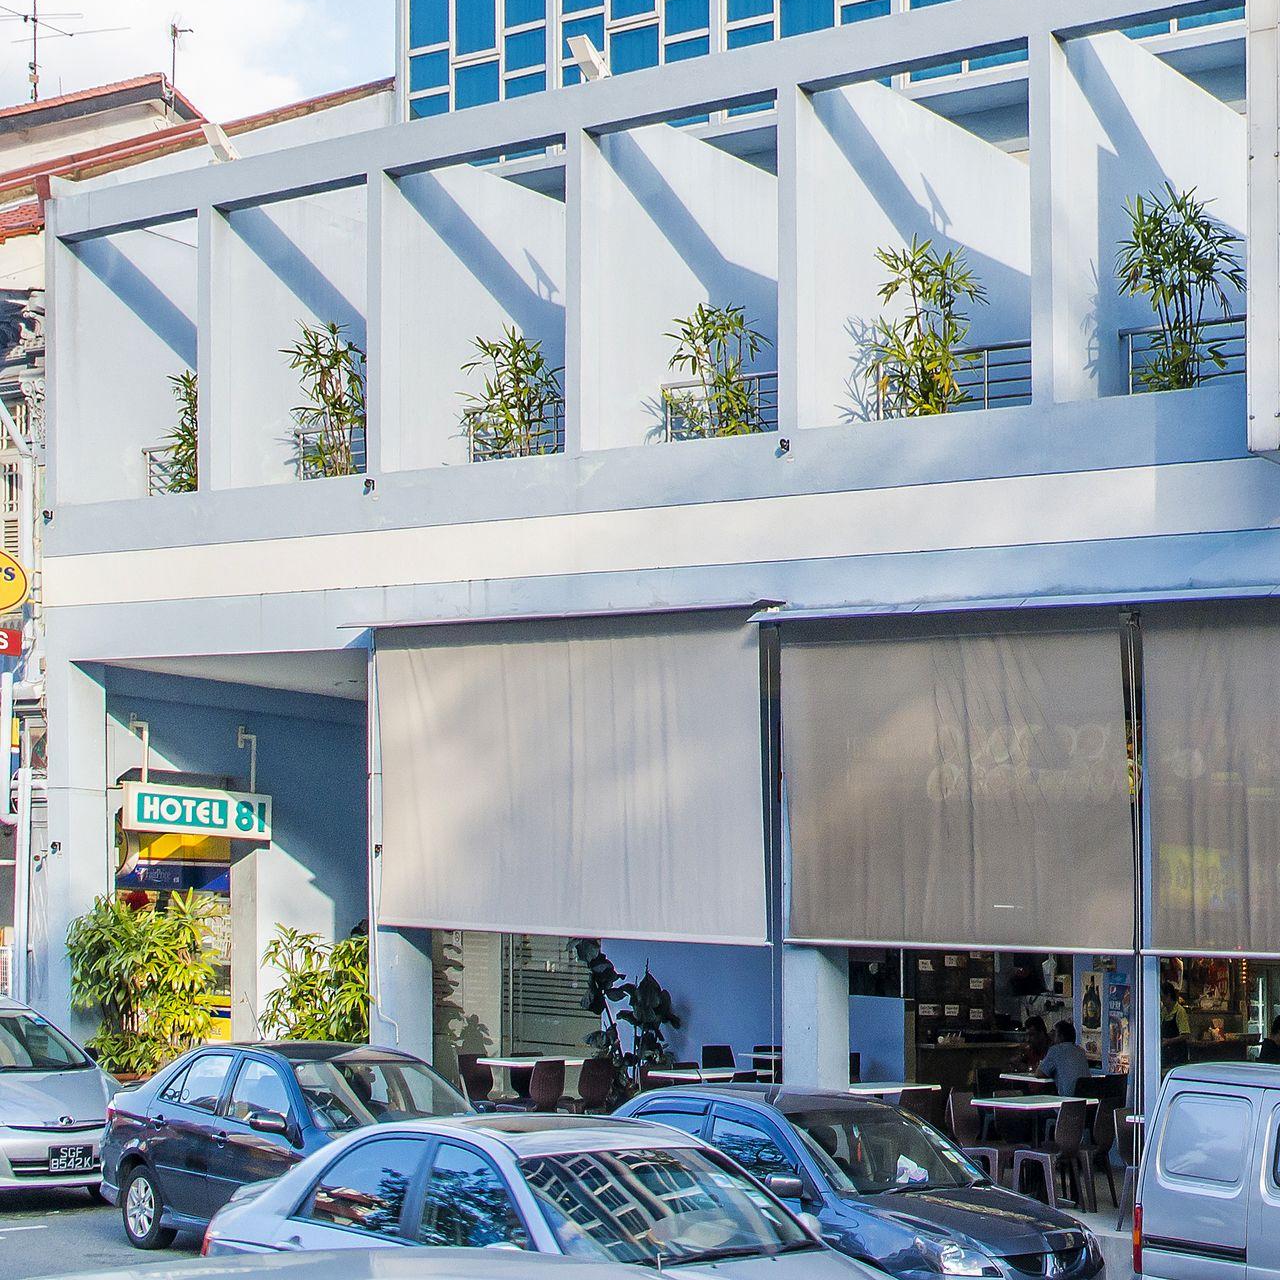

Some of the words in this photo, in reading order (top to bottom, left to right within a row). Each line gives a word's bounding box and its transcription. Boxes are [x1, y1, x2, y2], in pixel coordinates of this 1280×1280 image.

[143, 796, 225, 825] HOTEL
[235, 800, 266, 832] 81
[60, 1147, 84, 1159] SGF
